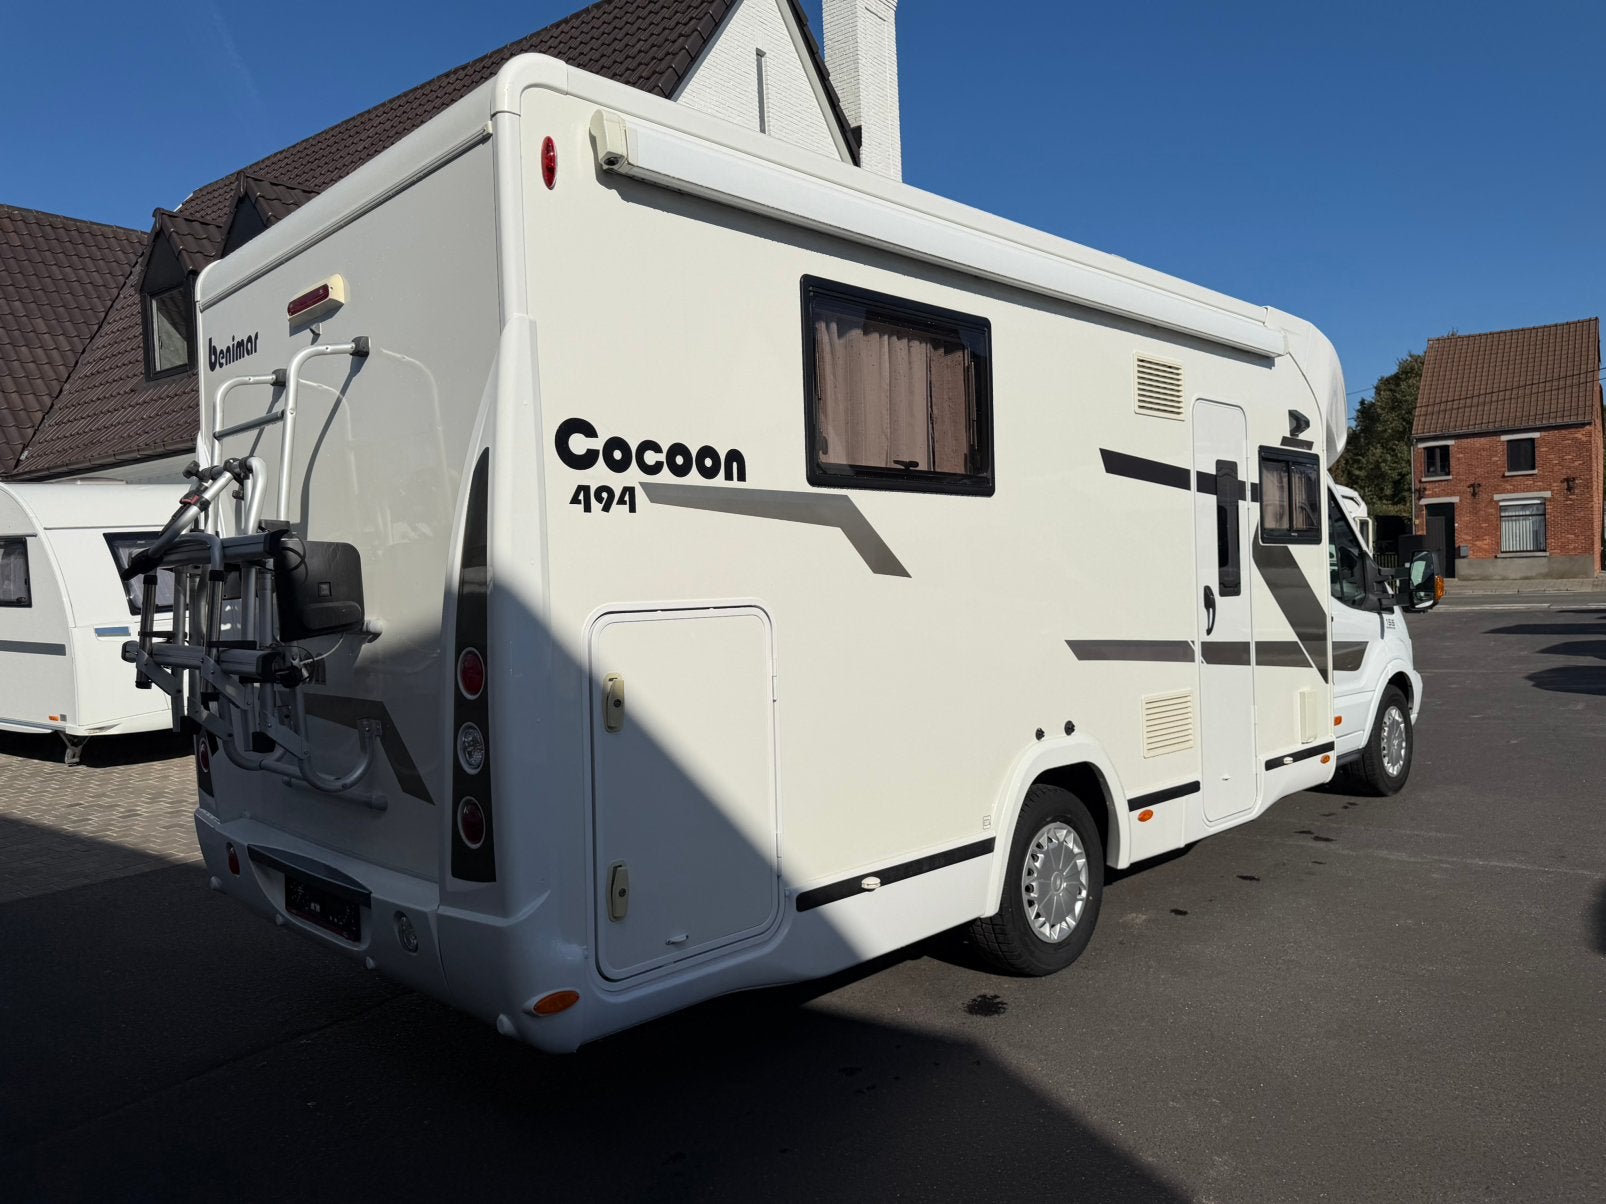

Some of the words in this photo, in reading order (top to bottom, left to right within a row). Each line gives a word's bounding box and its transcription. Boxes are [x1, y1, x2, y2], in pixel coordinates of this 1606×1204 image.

[208, 331, 259, 372] benimar
[554, 417, 747, 482] Cocoon
[569, 484, 637, 513] 494
